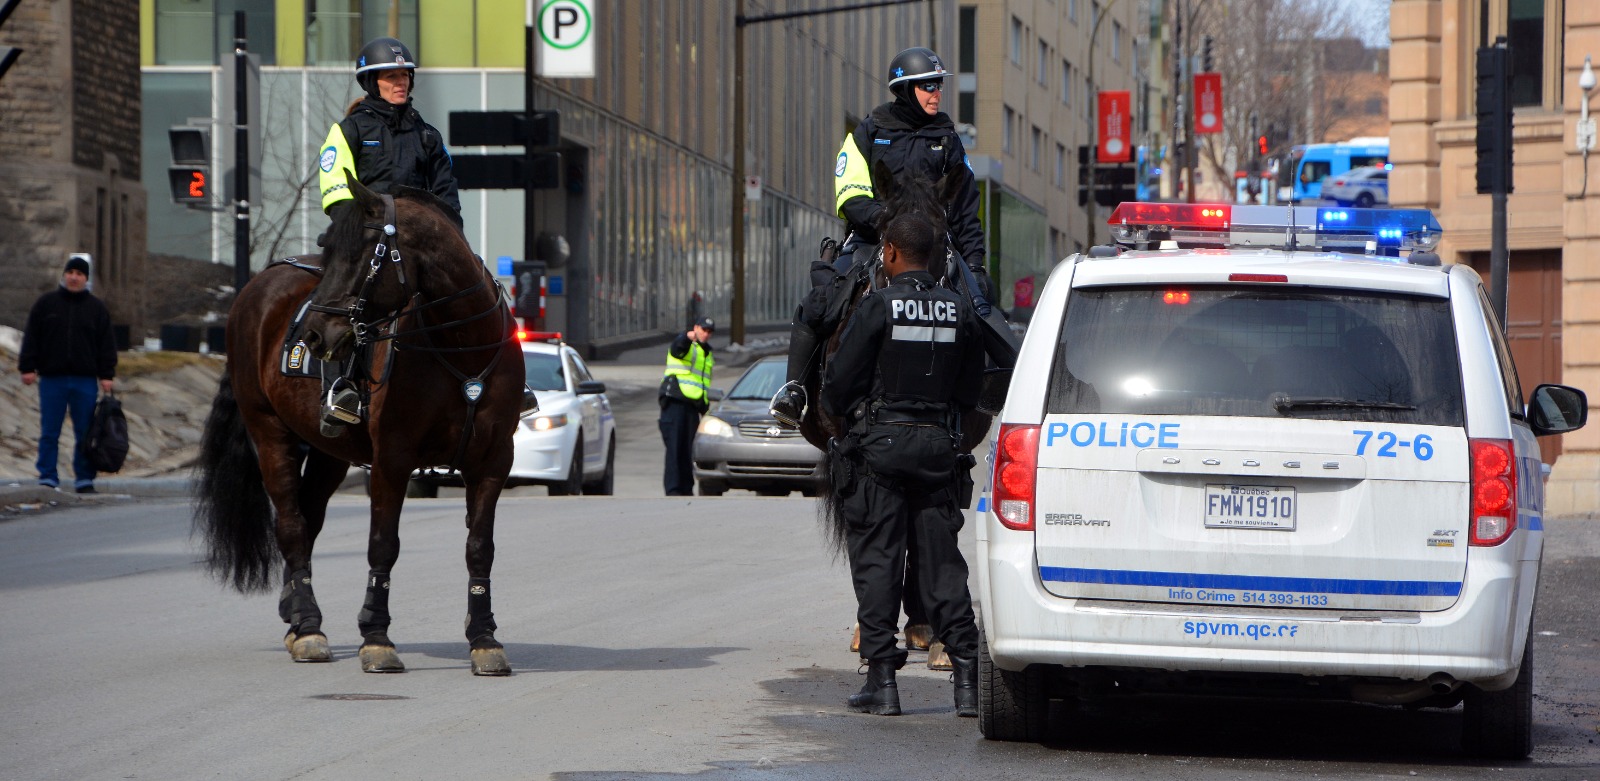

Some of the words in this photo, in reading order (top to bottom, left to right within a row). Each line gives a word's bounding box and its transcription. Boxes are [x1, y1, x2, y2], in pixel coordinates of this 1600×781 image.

[554, 8, 578, 39] P
[190, 172, 205, 197] 2
[892, 299, 957, 321] POLICE
[1047, 421, 1181, 449] POLICE
[1353, 429, 1434, 461] 72-6
[1163, 456, 1340, 470] DODGE
[1240, 487, 1270, 496] Québec
[1208, 494, 1292, 518] FMW1910
[1045, 519, 1111, 527] CARAVAN
[1433, 529, 1459, 537] SXT
[1168, 588, 1193, 600] Info
[1197, 590, 1236, 602] Crime
[1242, 592, 1266, 604] 514
[1269, 593, 1328, 606] 393-1133
